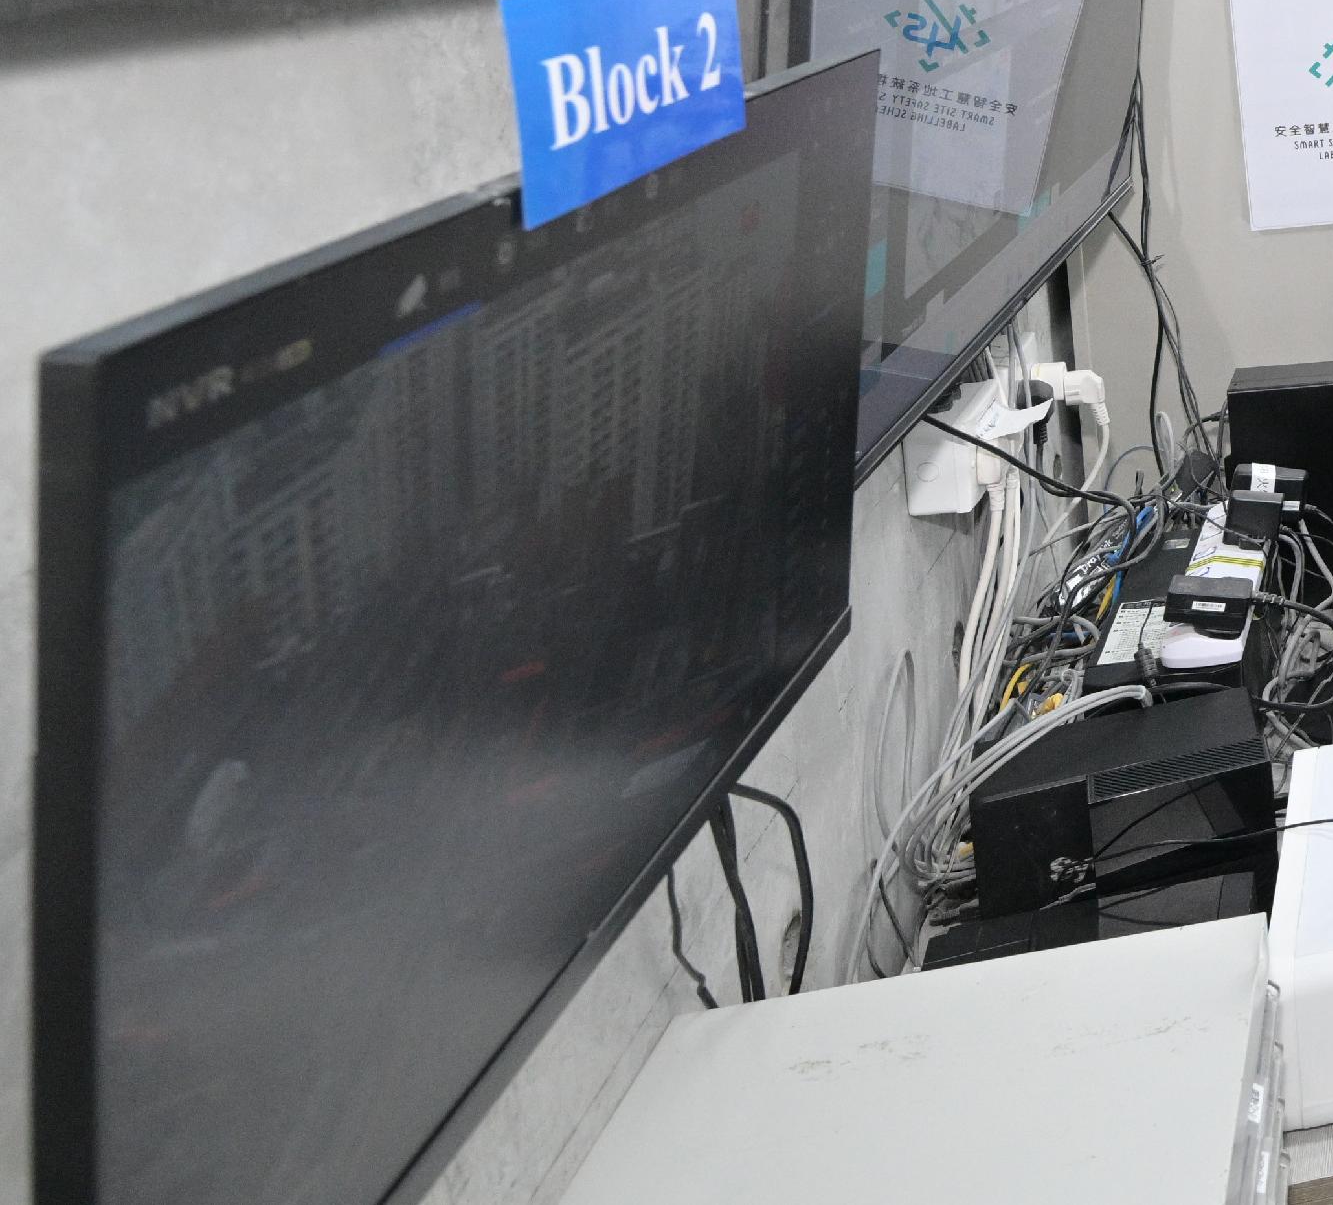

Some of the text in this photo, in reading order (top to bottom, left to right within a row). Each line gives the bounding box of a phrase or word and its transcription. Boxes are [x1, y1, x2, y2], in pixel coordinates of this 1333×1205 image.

[541, 11, 722, 153] Block 2
[1294, 139, 1324, 150] SMART
